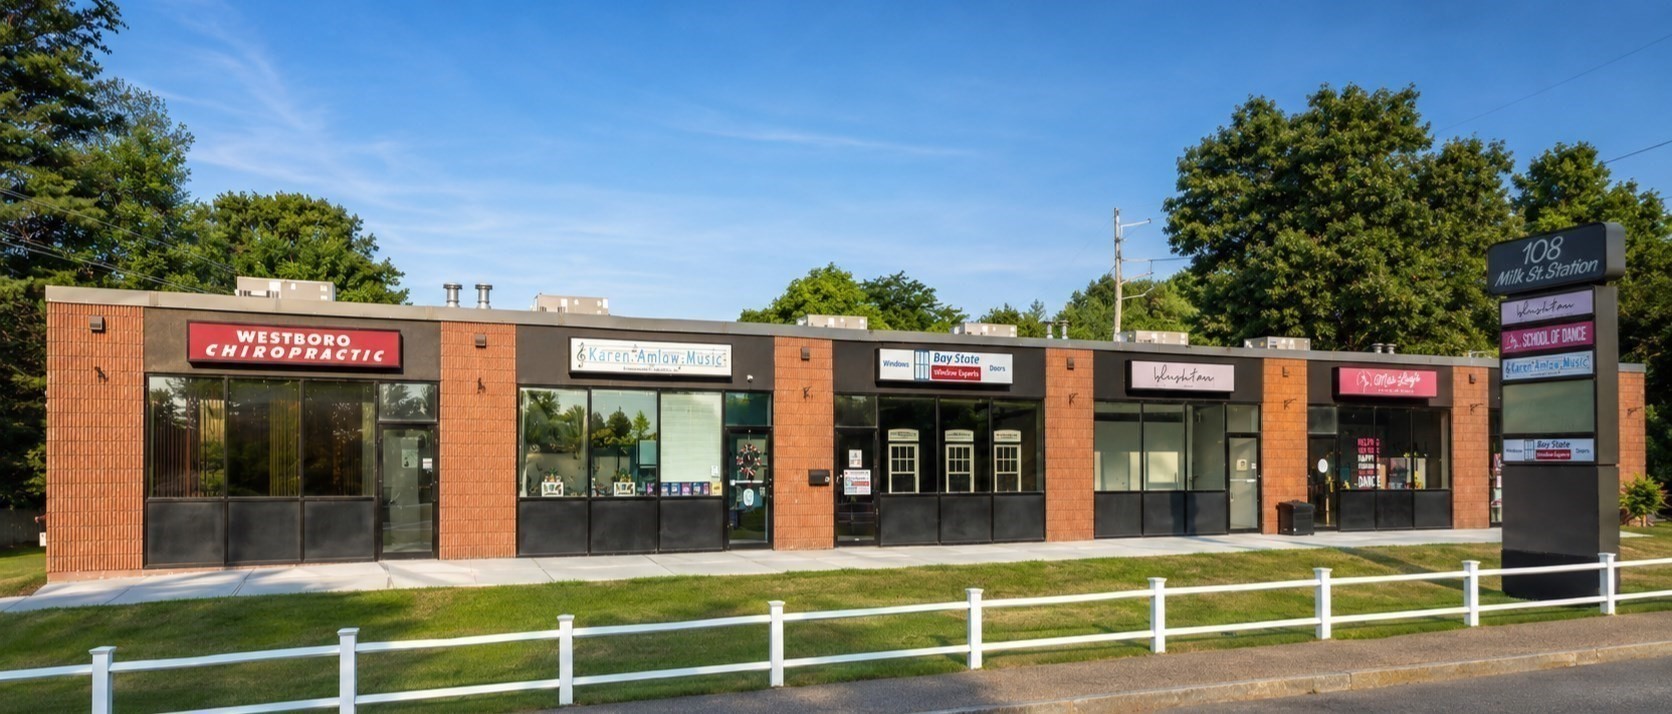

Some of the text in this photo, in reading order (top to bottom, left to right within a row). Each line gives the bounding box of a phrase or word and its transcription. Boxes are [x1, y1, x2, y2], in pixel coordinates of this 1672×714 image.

[1522, 236, 1563, 265] 108
[1495, 258, 1598, 287] Milk St. Station
[236, 330, 351, 346] WESTBORO
[1522, 326, 1587, 348] SCHOOL OF DANCE
[205, 343, 385, 362] CHIROPRACTIC
[933, 352, 980, 365] Bay State
[882, 359, 910, 369] Windows
[989, 364, 1006, 373] Doors
[1551, 440, 1571, 449] State
